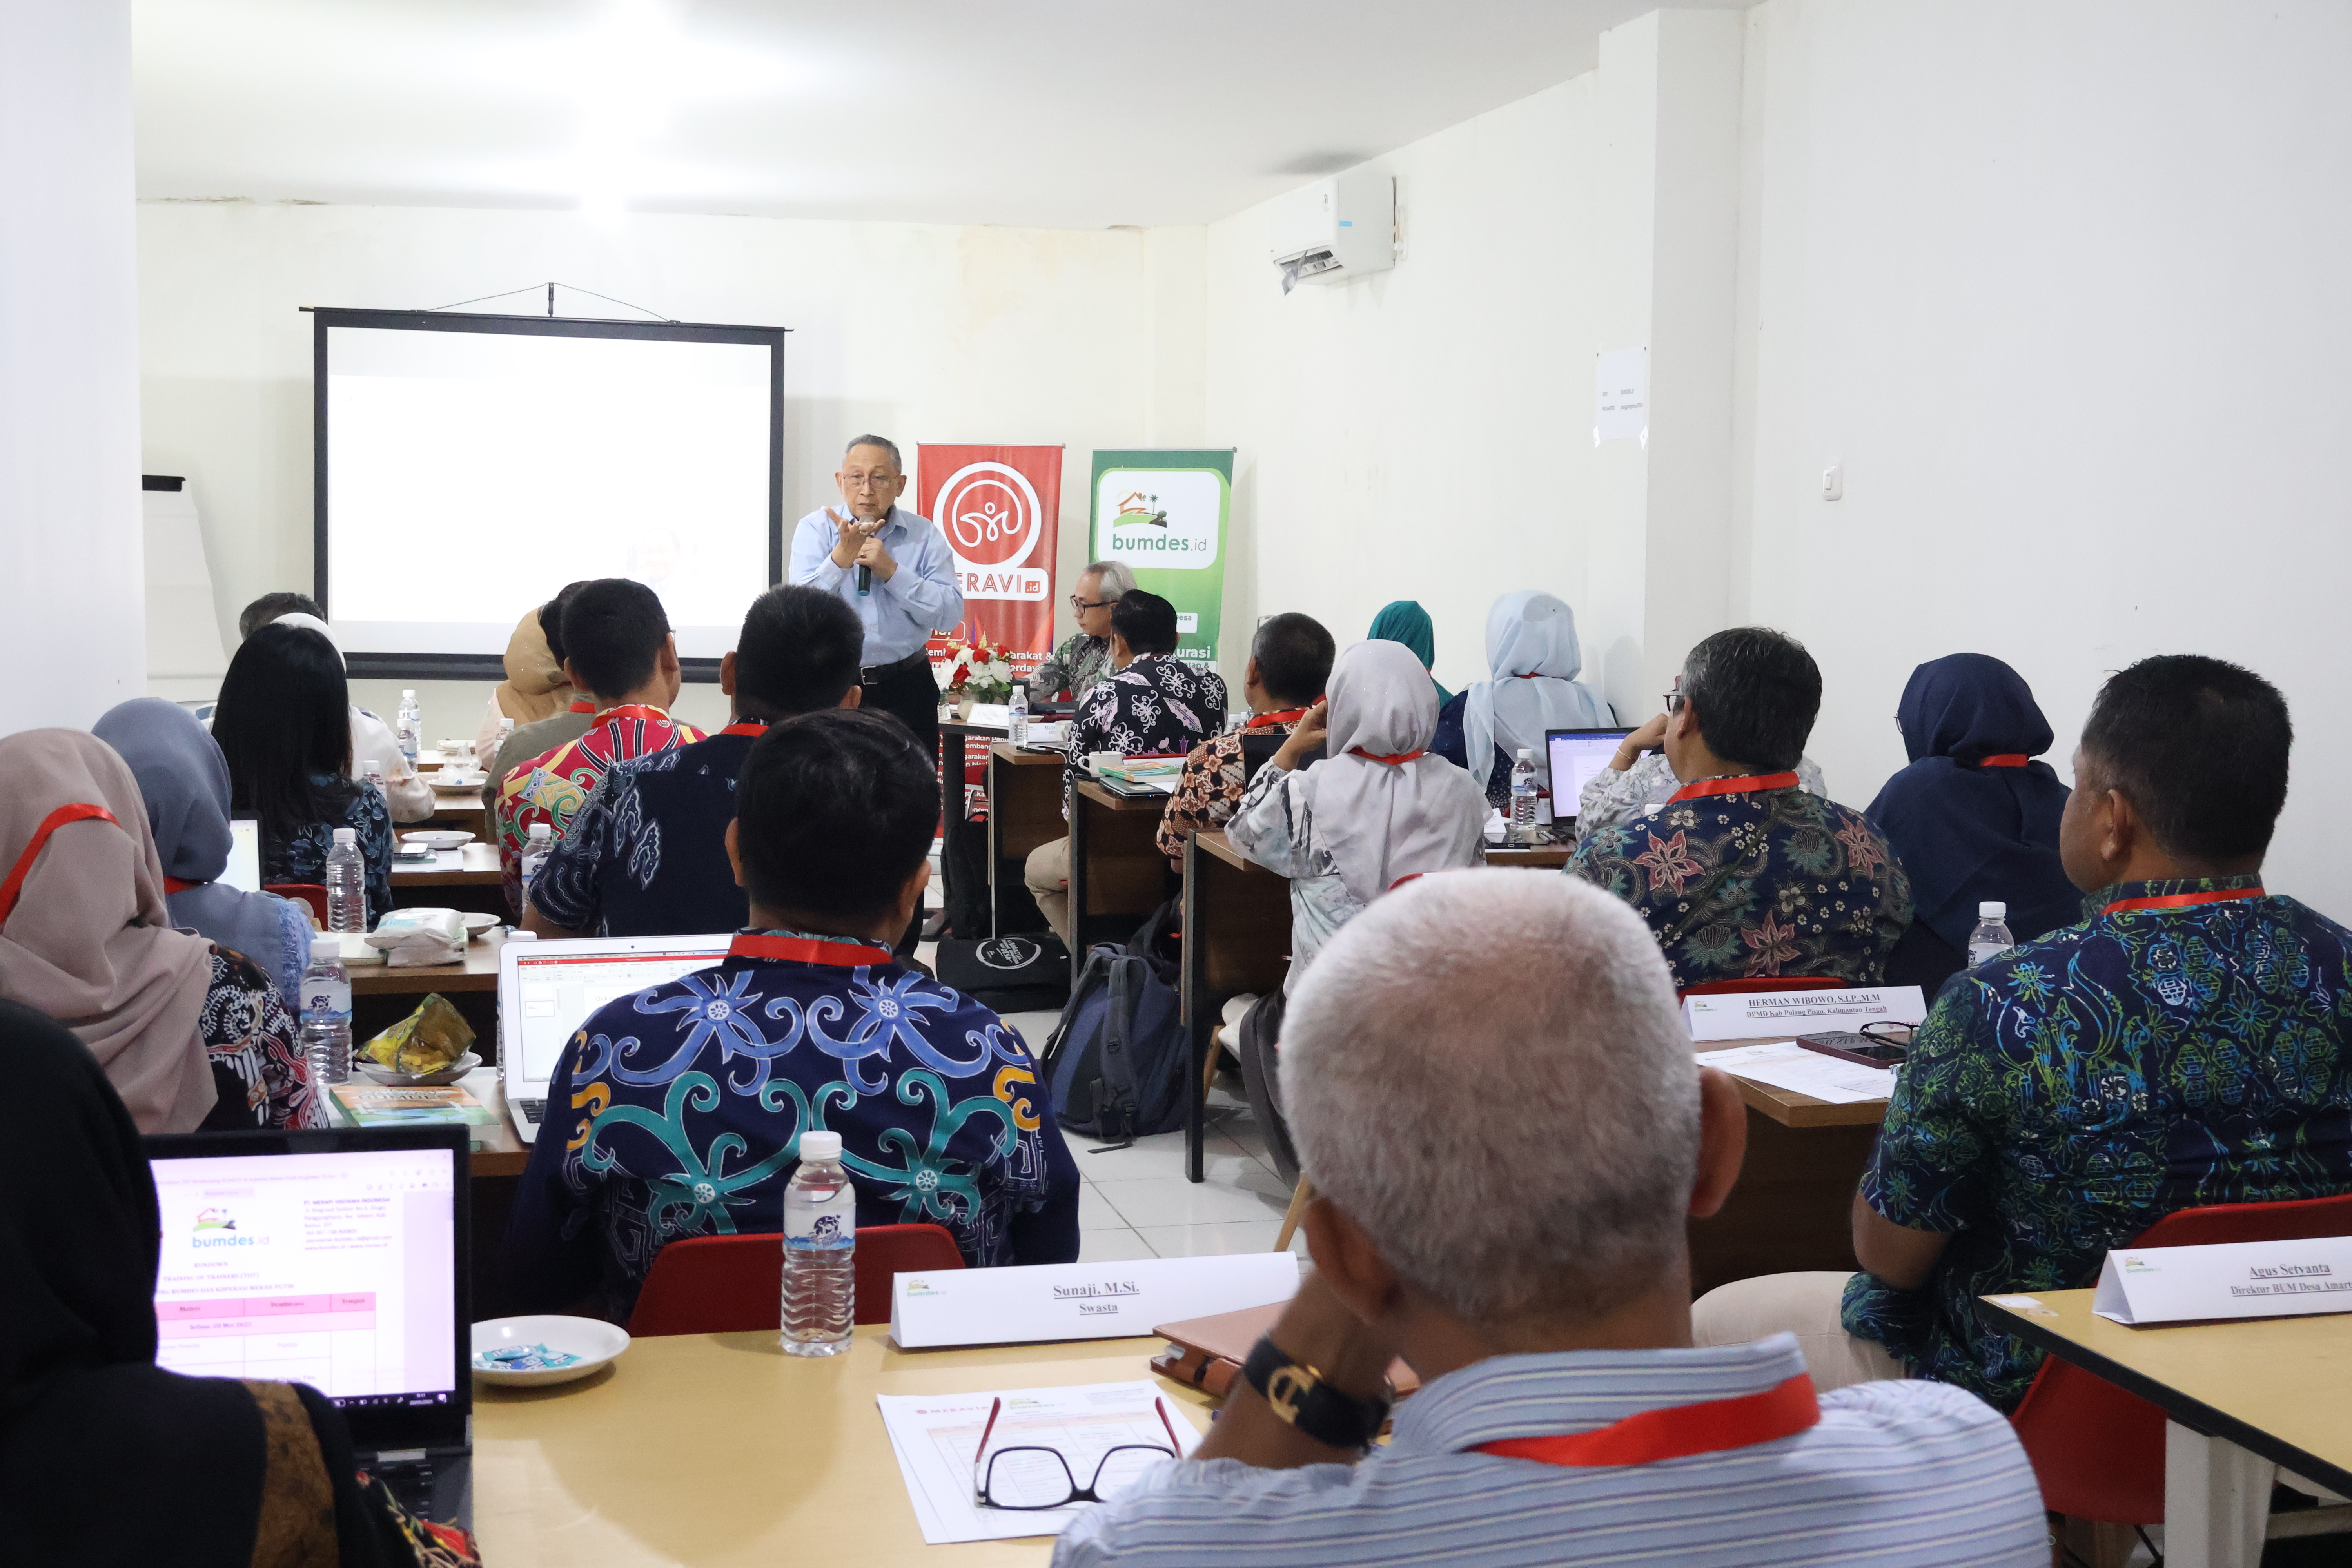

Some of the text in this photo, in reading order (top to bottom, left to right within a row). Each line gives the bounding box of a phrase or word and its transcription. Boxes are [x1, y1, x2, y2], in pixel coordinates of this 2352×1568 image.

[1112, 534, 1207, 551] bumdes.id
[1174, 646, 1211, 659] urasi
[1749, 998, 1790, 1007] HERMAN
[1792, 996, 1837, 1005] WIBOWO,
[192, 1234, 269, 1248] bumdes.id
[2249, 1264, 2331, 1277] Agus Setyanta
[1054, 1281, 1140, 1297] Sunaji, M.Si.
[2230, 1285, 2270, 1295] Direktur
[2272, 1283, 2297, 1293] BUM
[2299, 1282, 2321, 1291] Desa
[1079, 1303, 1118, 1313] Swasta
